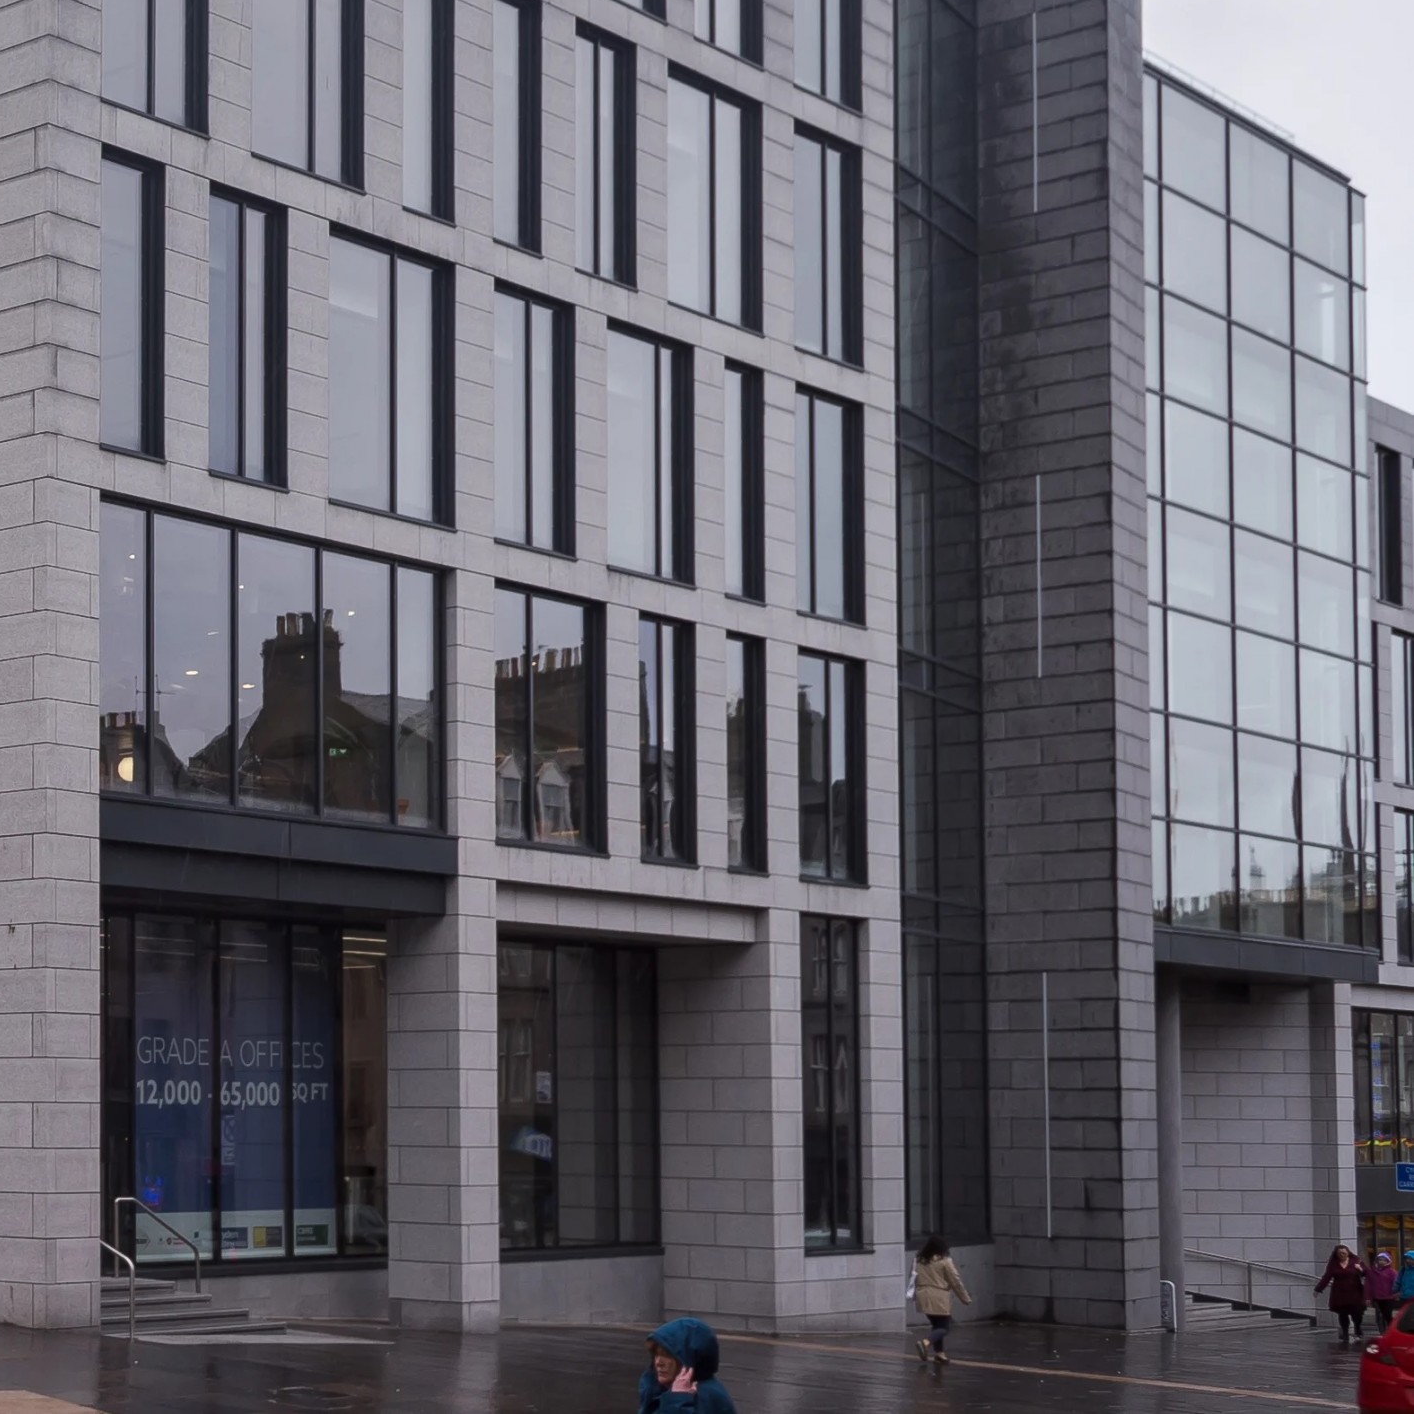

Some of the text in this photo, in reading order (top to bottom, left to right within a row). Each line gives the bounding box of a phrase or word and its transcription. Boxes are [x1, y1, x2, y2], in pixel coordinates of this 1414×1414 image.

[136, 1036, 210, 1066] GRADE
[220, 1040, 234, 1067] A
[136, 1079, 202, 1110] 12,000
[220, 1081, 280, 1111] 65,000
[311, 1082, 329, 1100] FT
